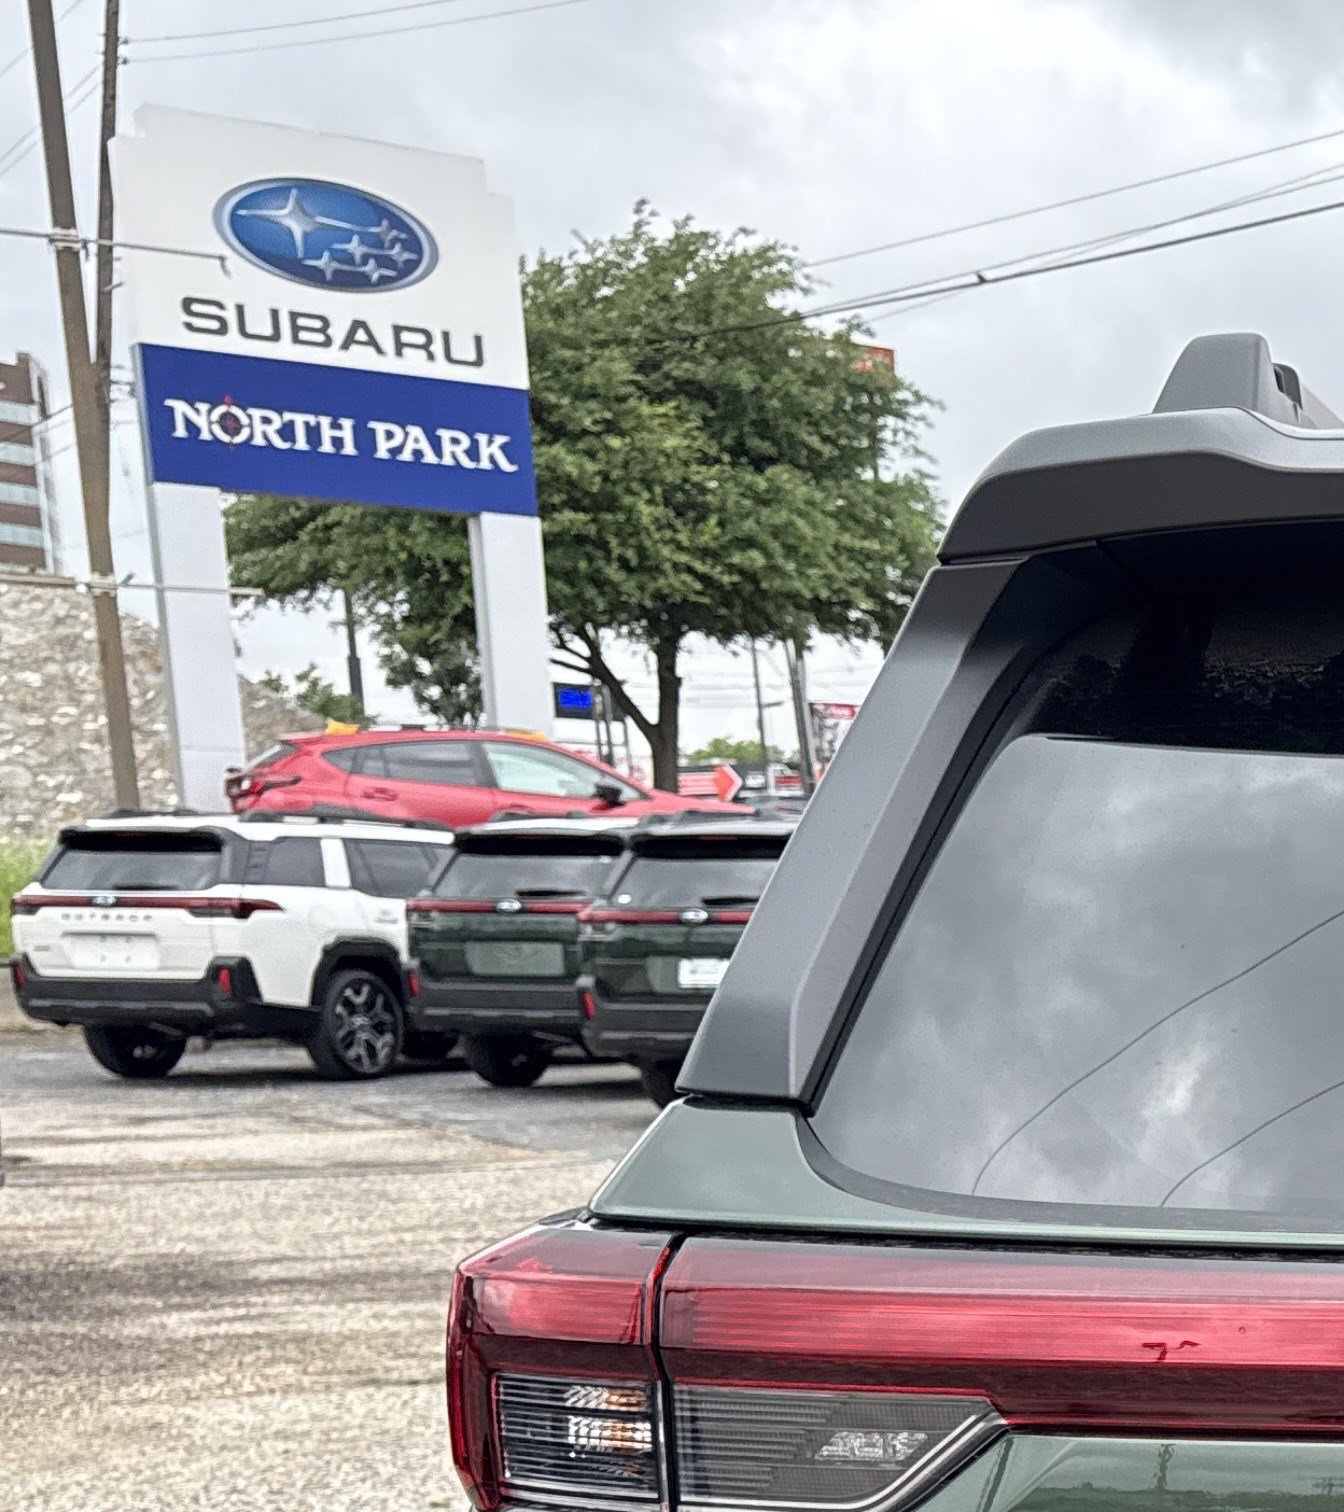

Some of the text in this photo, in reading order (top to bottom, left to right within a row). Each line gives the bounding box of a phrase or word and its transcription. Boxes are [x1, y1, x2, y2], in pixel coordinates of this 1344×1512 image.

[180, 295, 485, 369] SUBARU
[164, 397, 518, 475] NORTH PARK
